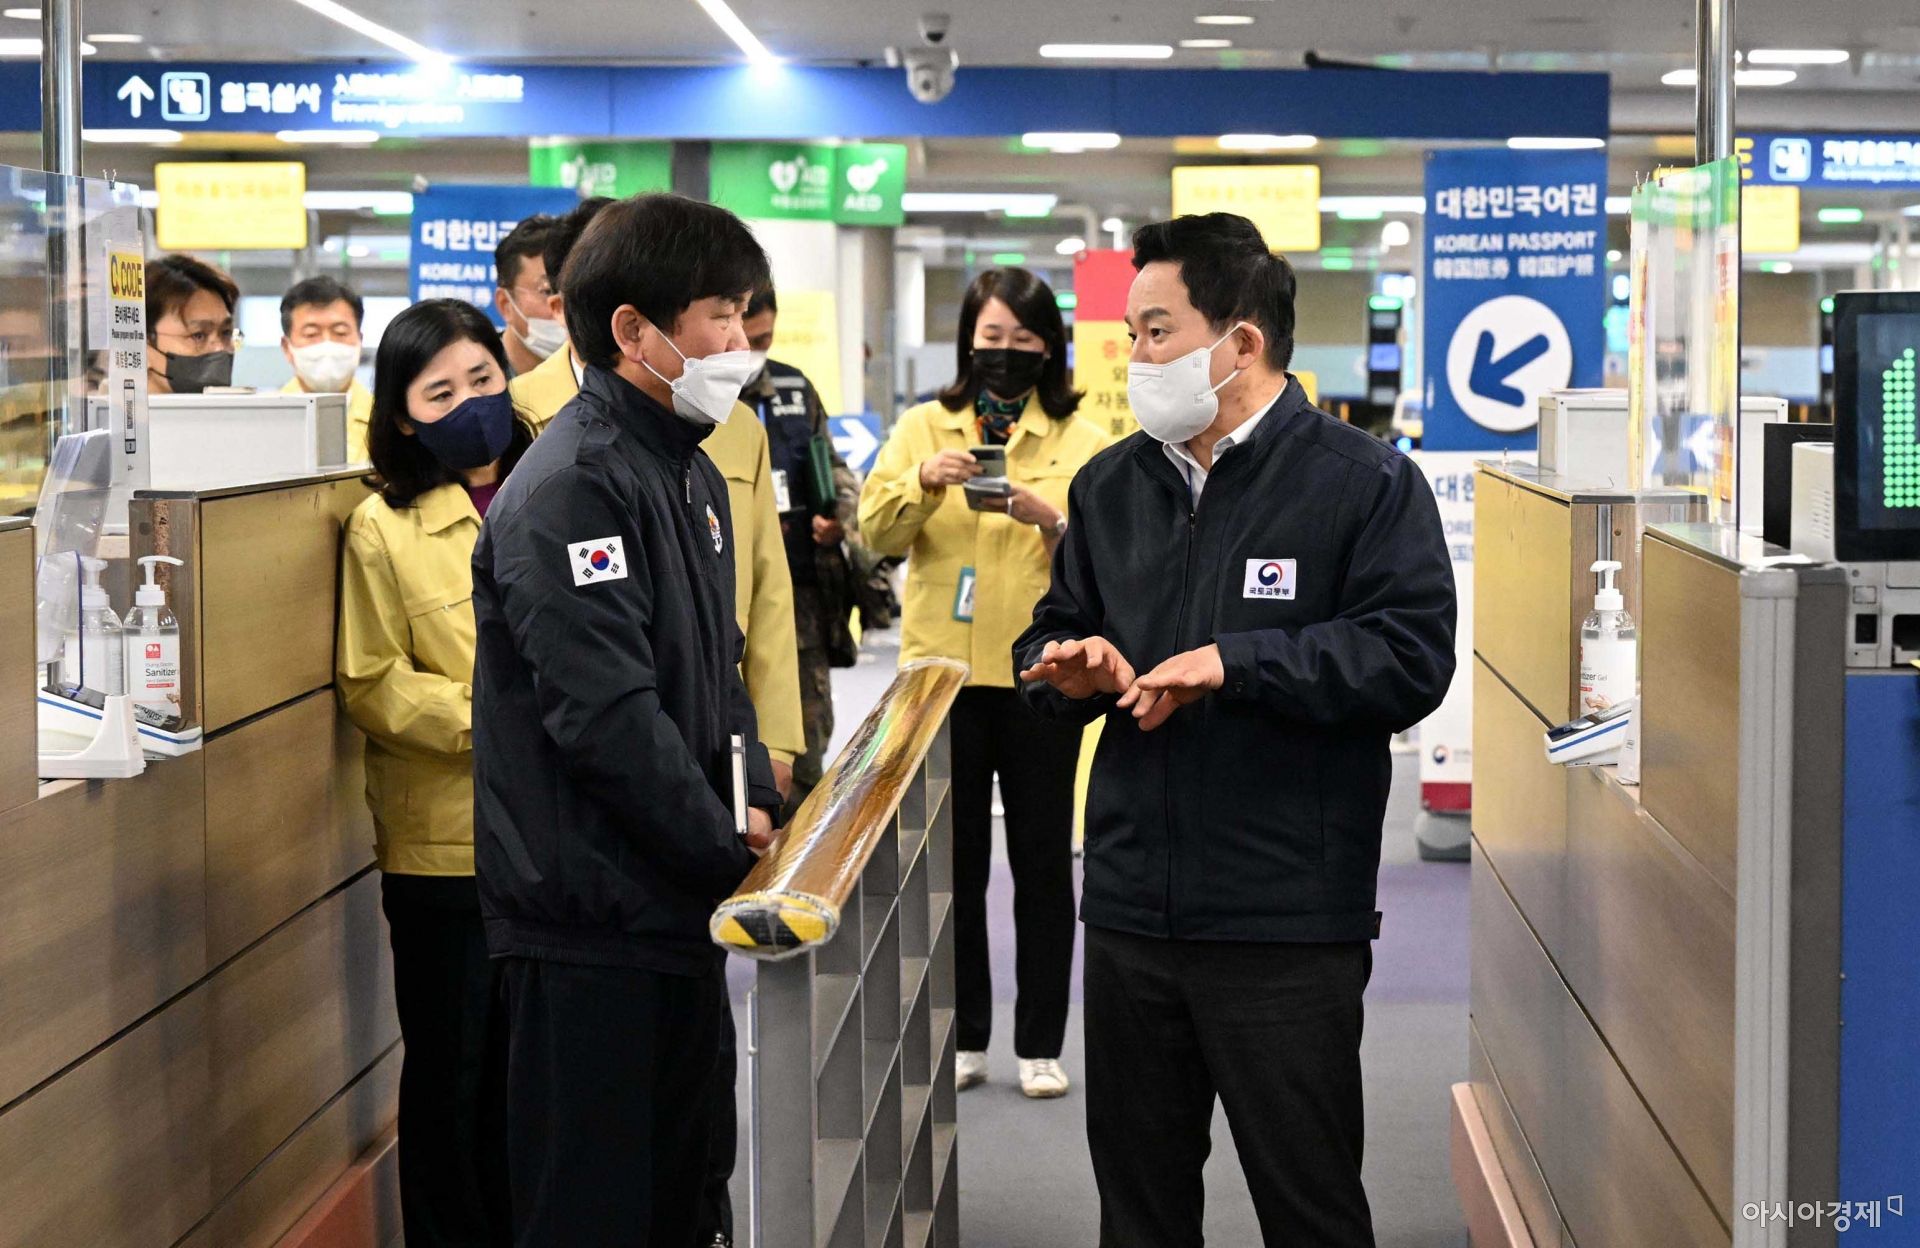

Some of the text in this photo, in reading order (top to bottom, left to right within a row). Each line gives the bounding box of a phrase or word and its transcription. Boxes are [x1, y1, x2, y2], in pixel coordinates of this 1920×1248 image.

[842, 193, 883, 212] AED
[1435, 183, 1598, 220] 대한민국여권
[1434, 230, 1597, 253] KOREAN PASSPORT
[121, 260, 143, 298] CODE
[419, 262, 487, 282] KOREAN
[1249, 587, 1290, 596] 국토교통부
[145, 668, 177, 677] Sanitizer
